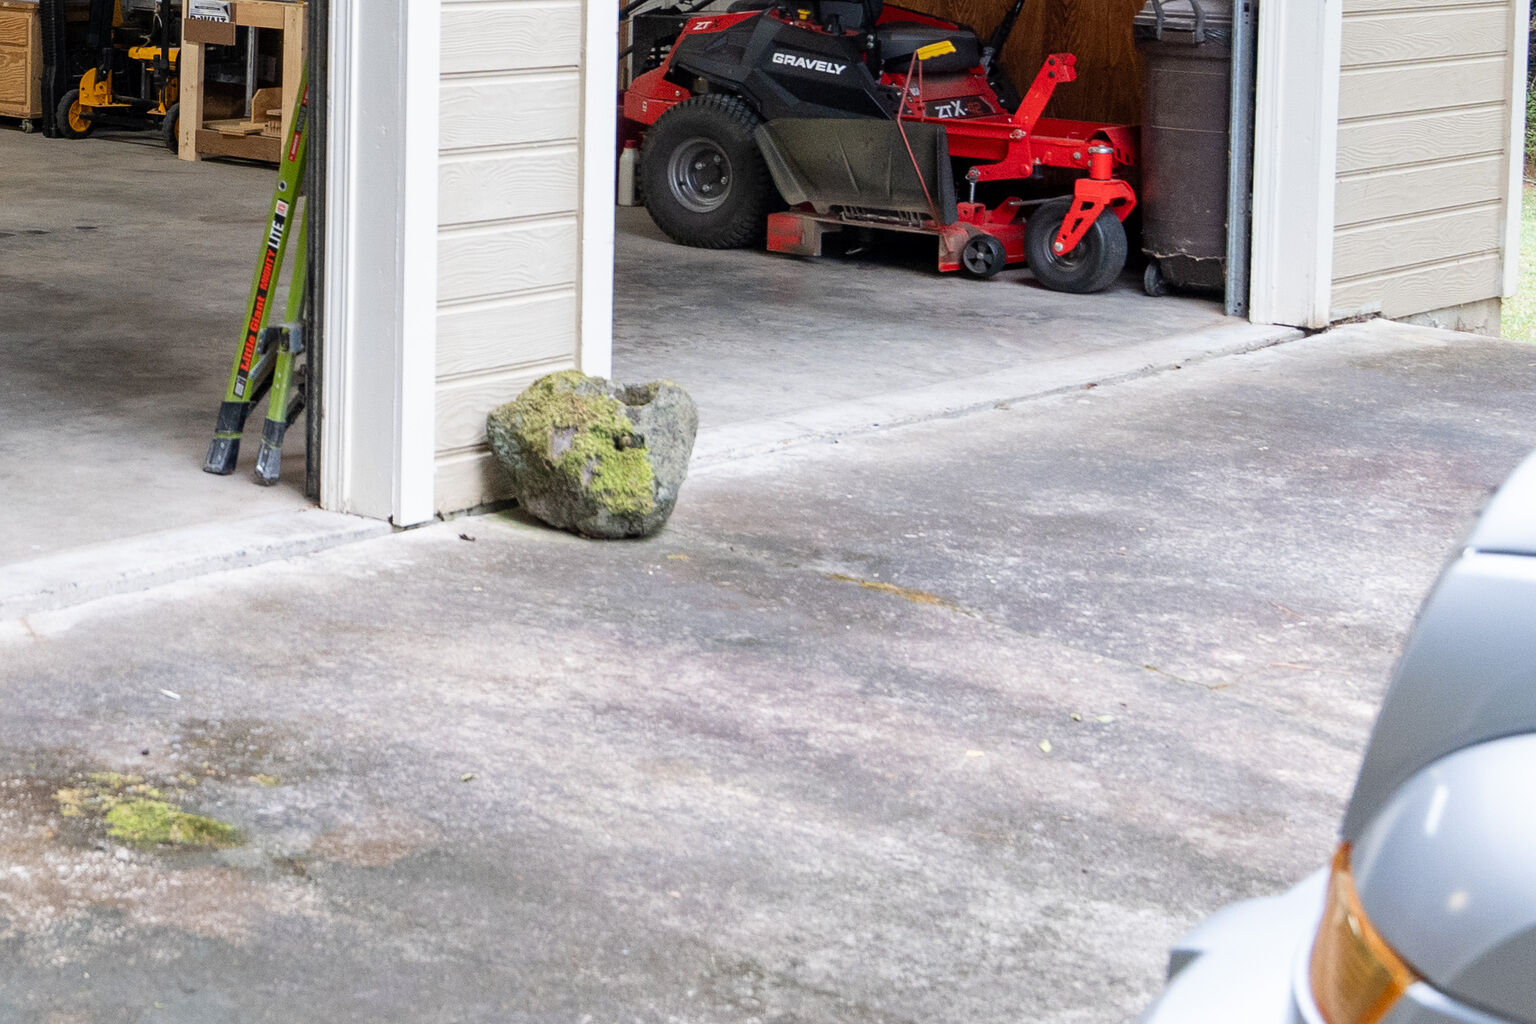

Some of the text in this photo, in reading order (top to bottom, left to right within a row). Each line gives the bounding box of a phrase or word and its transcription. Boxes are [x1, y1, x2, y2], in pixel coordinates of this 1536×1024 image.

[772, 52, 847, 75] GRAVELY
[240, 335, 256, 371] Little
[250, 296, 265, 332] Giant
[260, 249, 275, 290] MIGHTY
[268, 221, 284, 249] LITE
